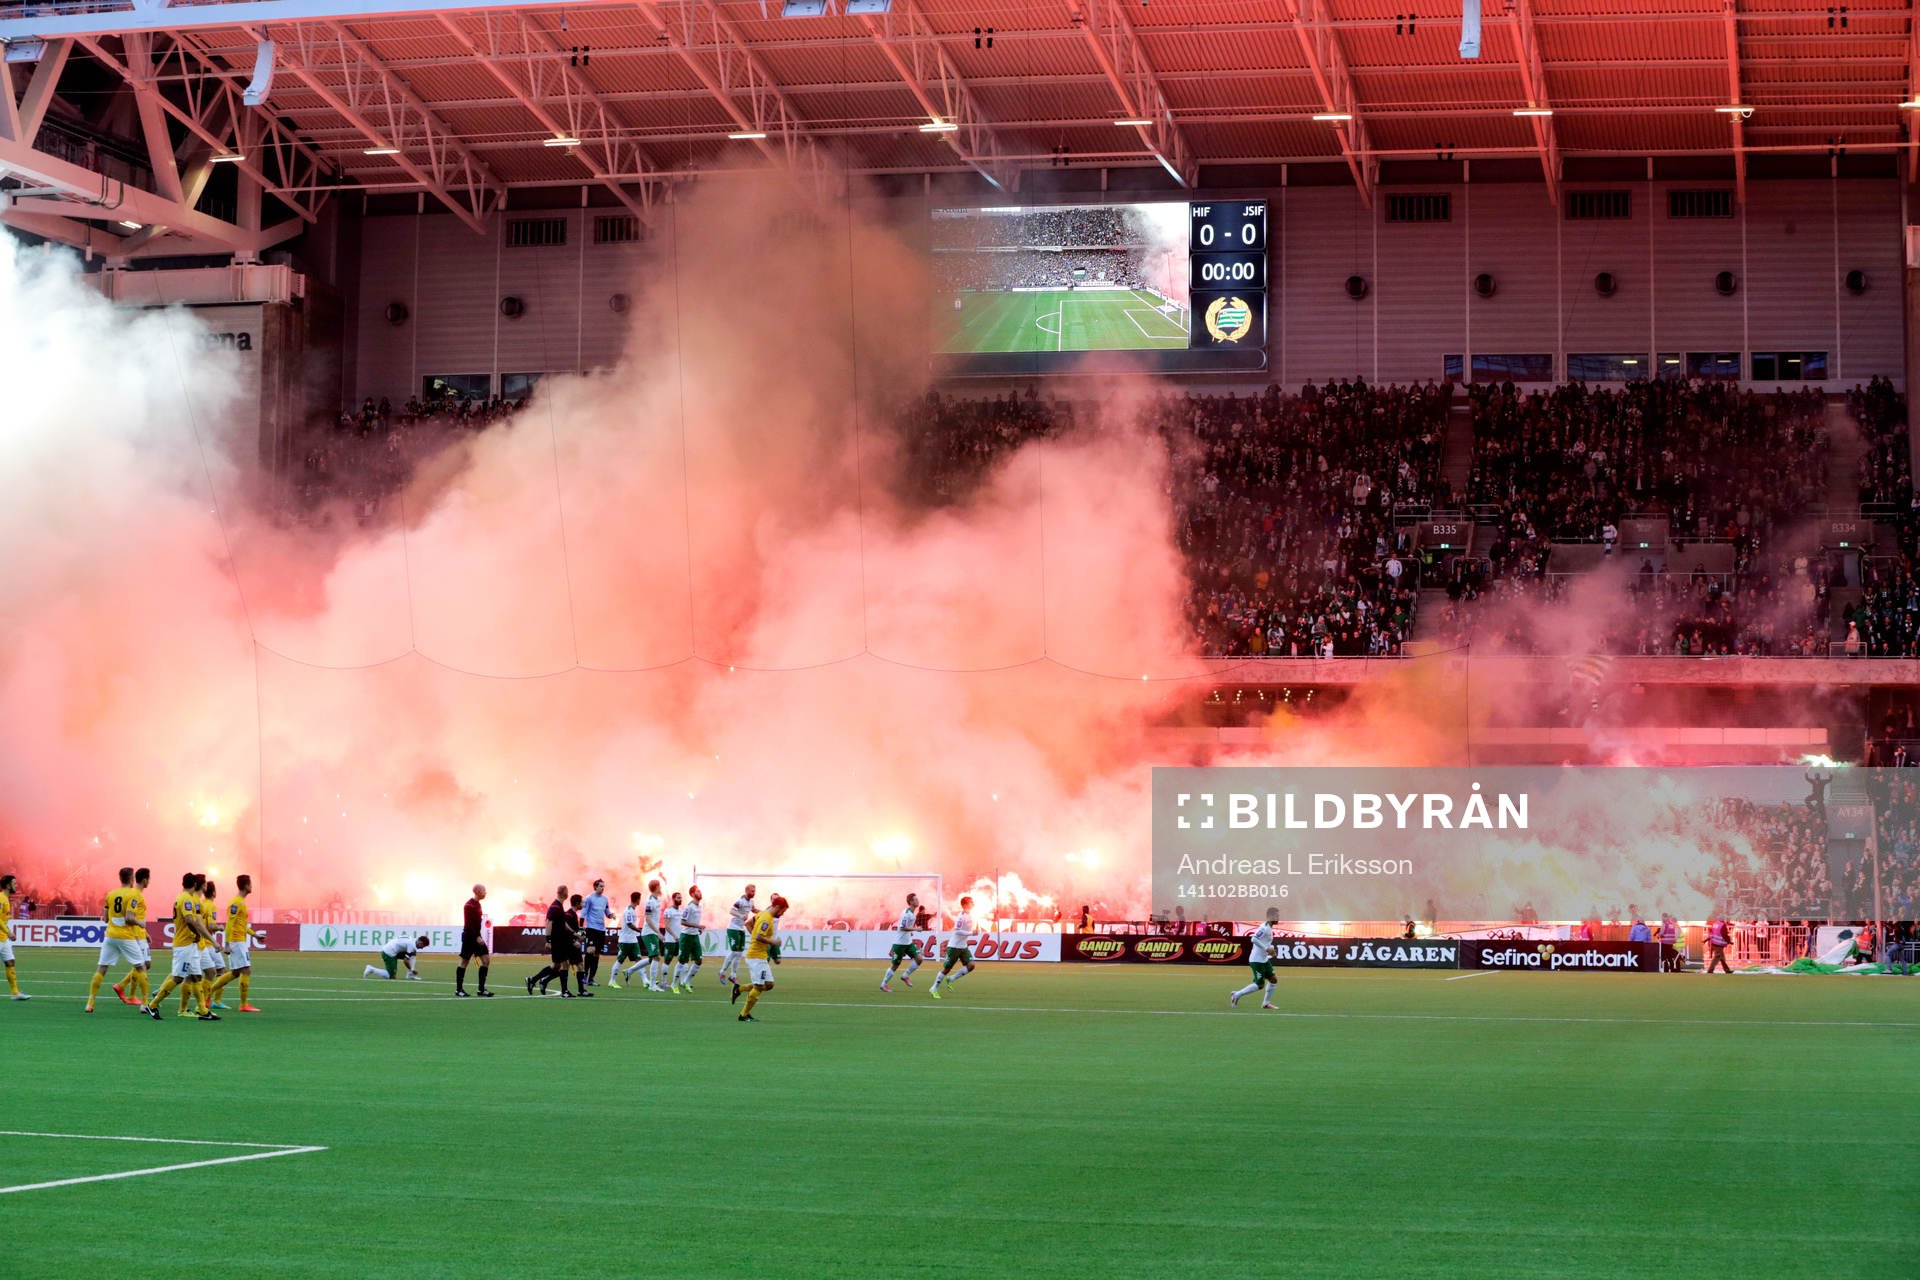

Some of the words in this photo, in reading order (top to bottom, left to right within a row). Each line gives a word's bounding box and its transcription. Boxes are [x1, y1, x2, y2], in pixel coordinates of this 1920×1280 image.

[1192, 207, 1211, 217] HIF
[1243, 206, 1264, 216] JSIF
[1200, 224, 1214, 245] 0
[1242, 224, 1256, 245] 0
[1201, 263, 1255, 280] 00:00
[1433, 525, 1457, 535] B335
[114, 896, 122, 913] 8
[1078, 940, 1125, 952] BANDIT
[1136, 941, 1183, 953] BANDIT
[1195, 942, 1242, 954] BANDIT
[1269, 941, 1339, 960] RÖNE
[1345, 943, 1456, 962] JÄGAREN
[1481, 948, 1541, 966] Sefina
[1551, 950, 1639, 969] pantbank
